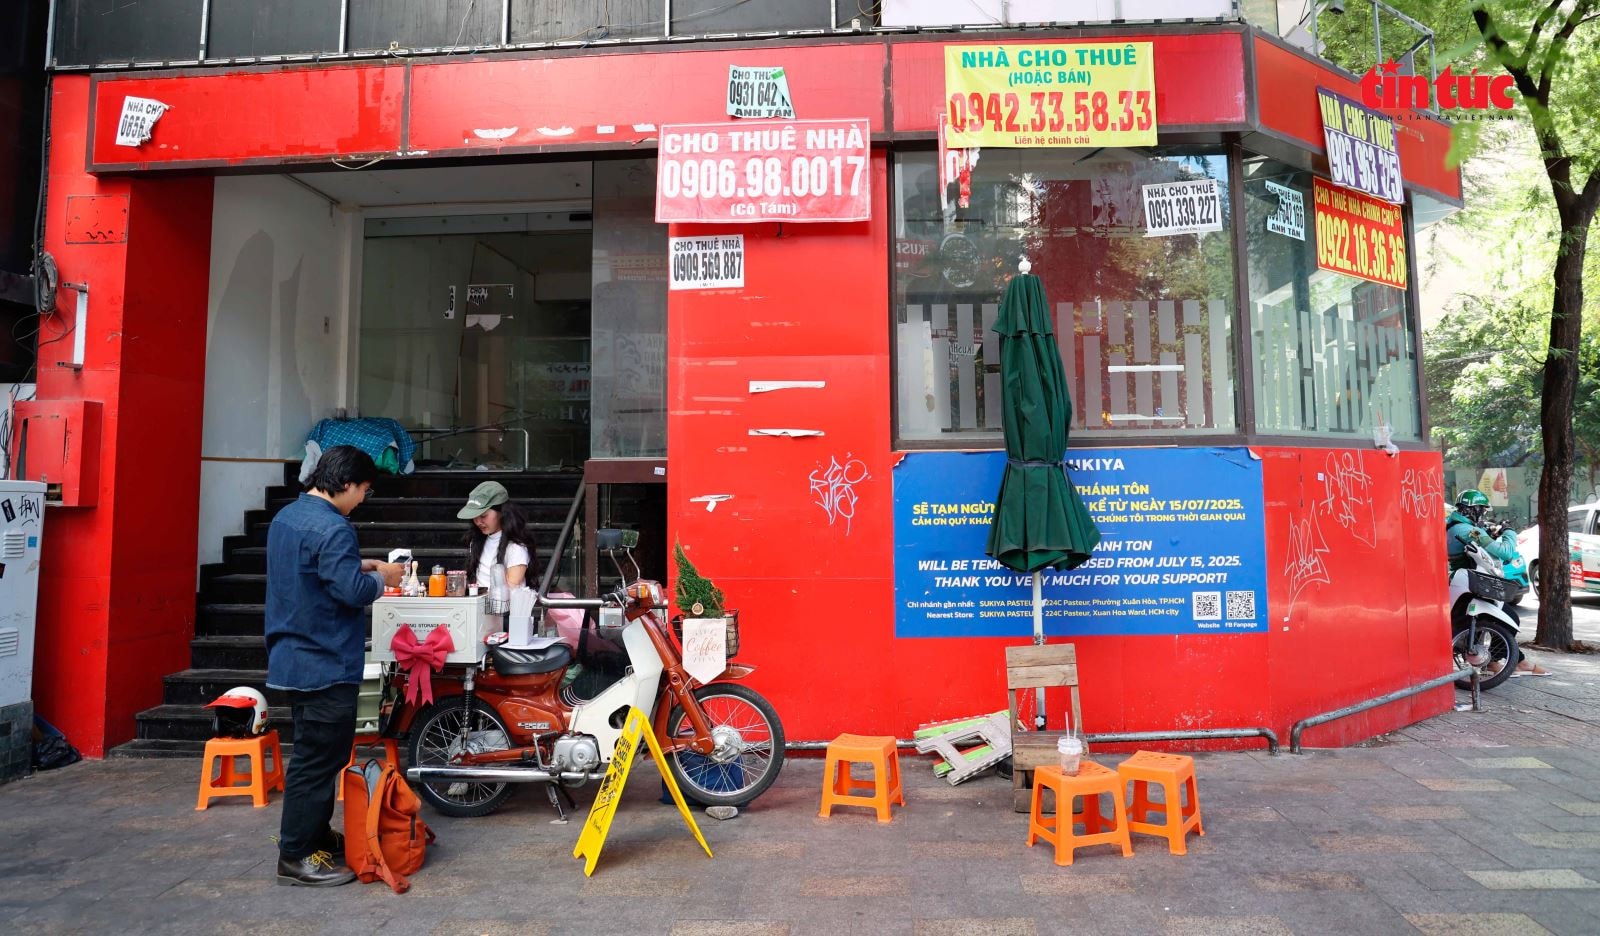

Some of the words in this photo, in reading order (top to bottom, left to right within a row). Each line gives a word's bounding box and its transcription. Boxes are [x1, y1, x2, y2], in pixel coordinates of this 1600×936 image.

[962, 46, 1010, 68] NHÀ
[1018, 49, 1067, 67] CHO
[1075, 44, 1137, 66] THUÊ
[732, 69, 751, 80] CHO
[753, 69, 776, 80] THU
[1008, 69, 1053, 88] (HOẶC
[1058, 68, 1092, 86] BÁN)
[127, 99, 144, 113] NHÀ
[734, 108, 762, 117] ANH
[950, 90, 1153, 133] 0942.33.58.33
[1343, 103, 1368, 141] CHO
[664, 132, 719, 154] CHO
[728, 126, 797, 152] THUÊ
[806, 123, 865, 150] NHÀ
[1014, 135, 1032, 145] Liên
[1035, 135, 1045, 147] hệ
[662, 156, 866, 198] 0906.98.0017
[1147, 185, 1167, 199] NHÀ
[1168, 185, 1188, 196] CHO
[1190, 180, 1215, 195] THUÊ
[730, 203, 756, 217] (Cô
[759, 202, 797, 216] Tám)
[1149, 195, 1217, 229] 0931.339.227
[1315, 185, 1329, 206] CHO
[1331, 190, 1347, 212] THUÊ
[1348, 194, 1362, 217] NHÀ
[1362, 199, 1381, 223] CHÍNH
[674, 241, 693, 252] CHO
[696, 237, 720, 251] THUÊ
[722, 236, 741, 250] NHÀ
[1317, 211, 1406, 285] 0922.16.36.36
[673, 251, 743, 282] 0909.569.887
[1066, 458, 1125, 471] UKIYA
[1122, 481, 1149, 495] TÔN
[912, 501, 929, 515] SẼ
[931, 503, 958, 517] TẠM
[1089, 497, 1107, 512] KỂ
[1108, 498, 1129, 511] TỪ
[1130, 497, 1166, 511] NGÀY
[1169, 498, 1244, 511] 15/07/2025.
[912, 516, 932, 526] CẢM
[933, 517, 947, 526] ƠN
[948, 516, 966, 527] QUÝ
[1097, 513, 1128, 523] CHÚNG
[1130, 512, 1145, 522] TÔI
[1146, 513, 1175, 522] TRONG
[1177, 512, 1199, 522] THỜI
[1200, 513, 1222, 521] GIAN
[1223, 512, 1245, 522] QUA!
[1093, 541, 1122, 552] ANH
[1125, 540, 1153, 551] TON
[918, 560, 950, 571] WILL
[951, 560, 968, 571] BE
[1117, 557, 1154, 569] FROM
[1156, 556, 1188, 568] JULY
[1190, 556, 1206, 568] 15,
[1207, 555, 1242, 567] 2025.
[935, 576, 981, 588] THANK
[984, 576, 1011, 587] YOU
[1015, 575, 1049, 586] VEY
[1052, 575, 1091, 586] MUCH
[1093, 574, 1120, 585] FOR
[1124, 574, 1159, 585] YOUR
[1162, 573, 1228, 585] SUPPORT!
[1063, 599, 1091, 607] Pasteur,
[927, 611, 953, 619] Nearest
[954, 611, 975, 619] Store:
[979, 610, 1005, 618] SUKIYA
[1063, 610, 1091, 618] Pasteur,
[1165, 608, 1179, 617] city
[1233, 621, 1258, 629] Fanpage
